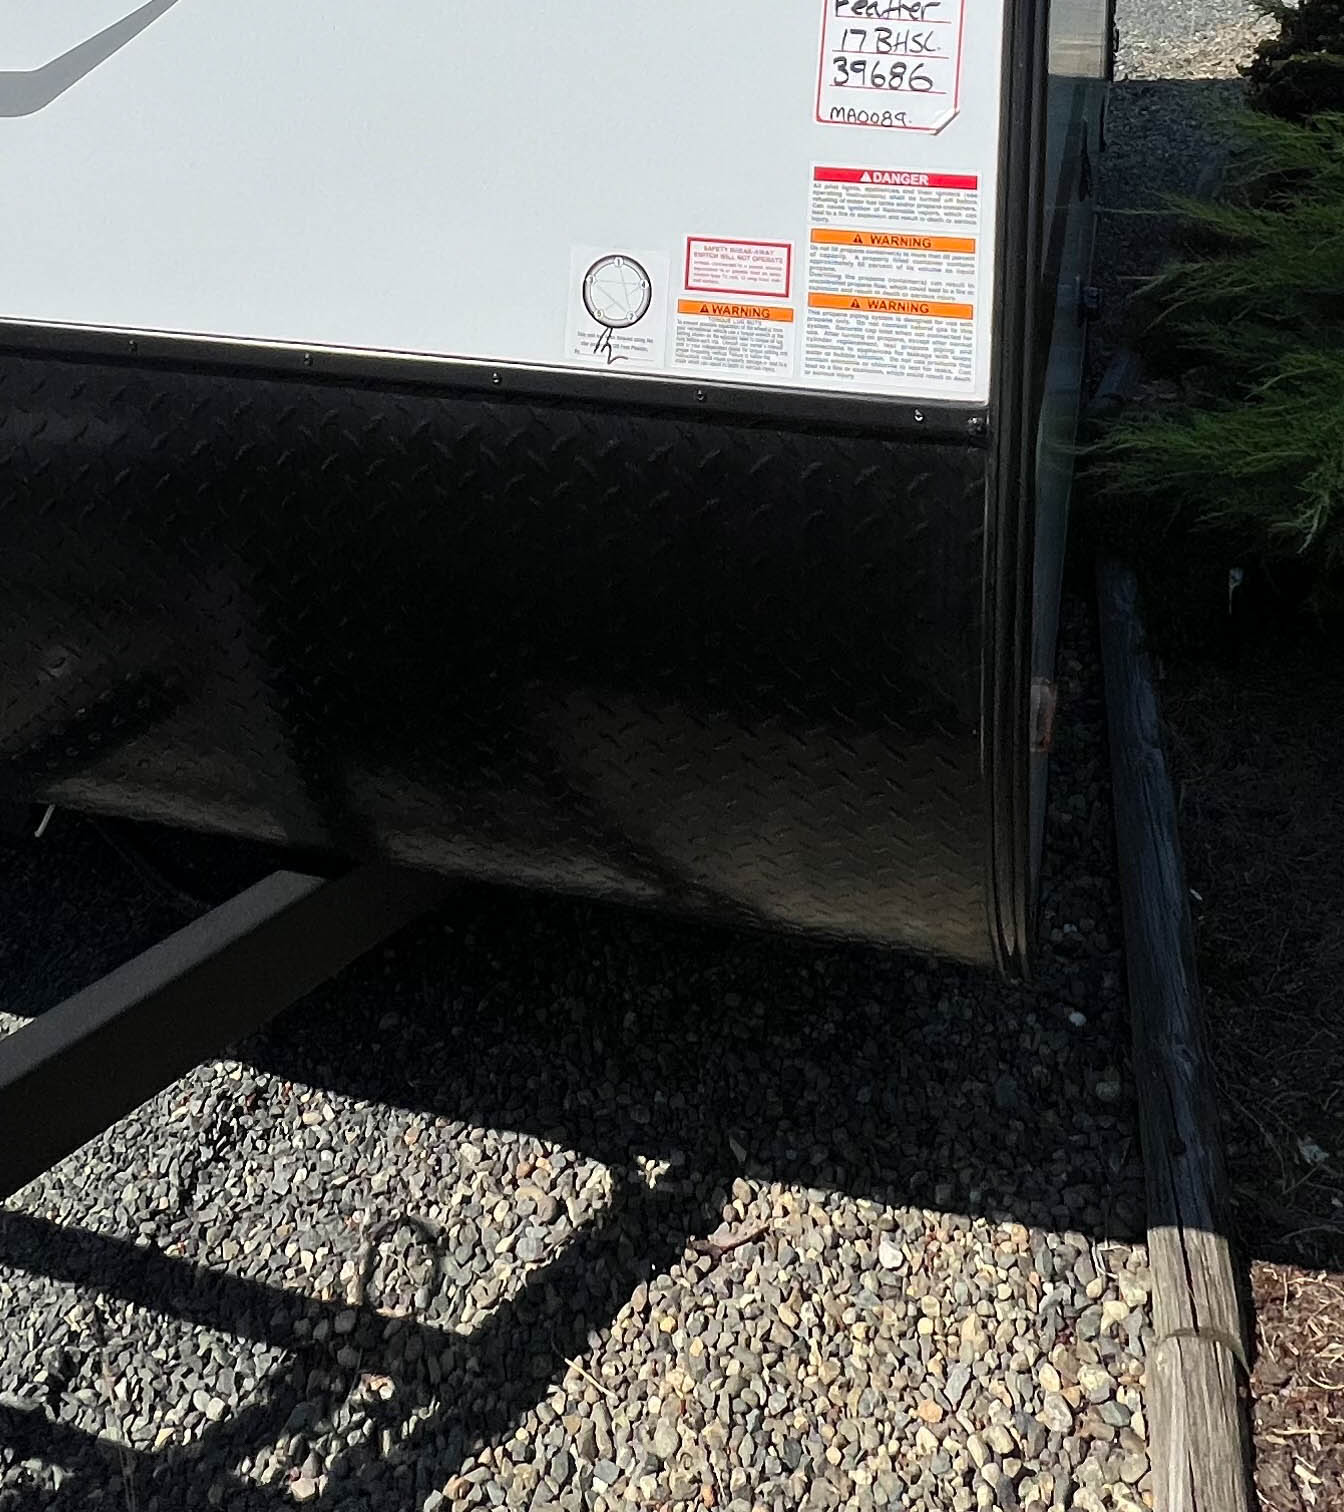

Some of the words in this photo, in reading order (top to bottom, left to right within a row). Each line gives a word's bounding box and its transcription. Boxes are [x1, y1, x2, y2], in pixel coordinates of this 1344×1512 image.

[833, 56, 933, 92] 39686
[872, 171, 929, 185] DANGER
[870, 235, 932, 248] WARNING
[712, 304, 770, 318] WARNING
[867, 298, 929, 313] WARNING
